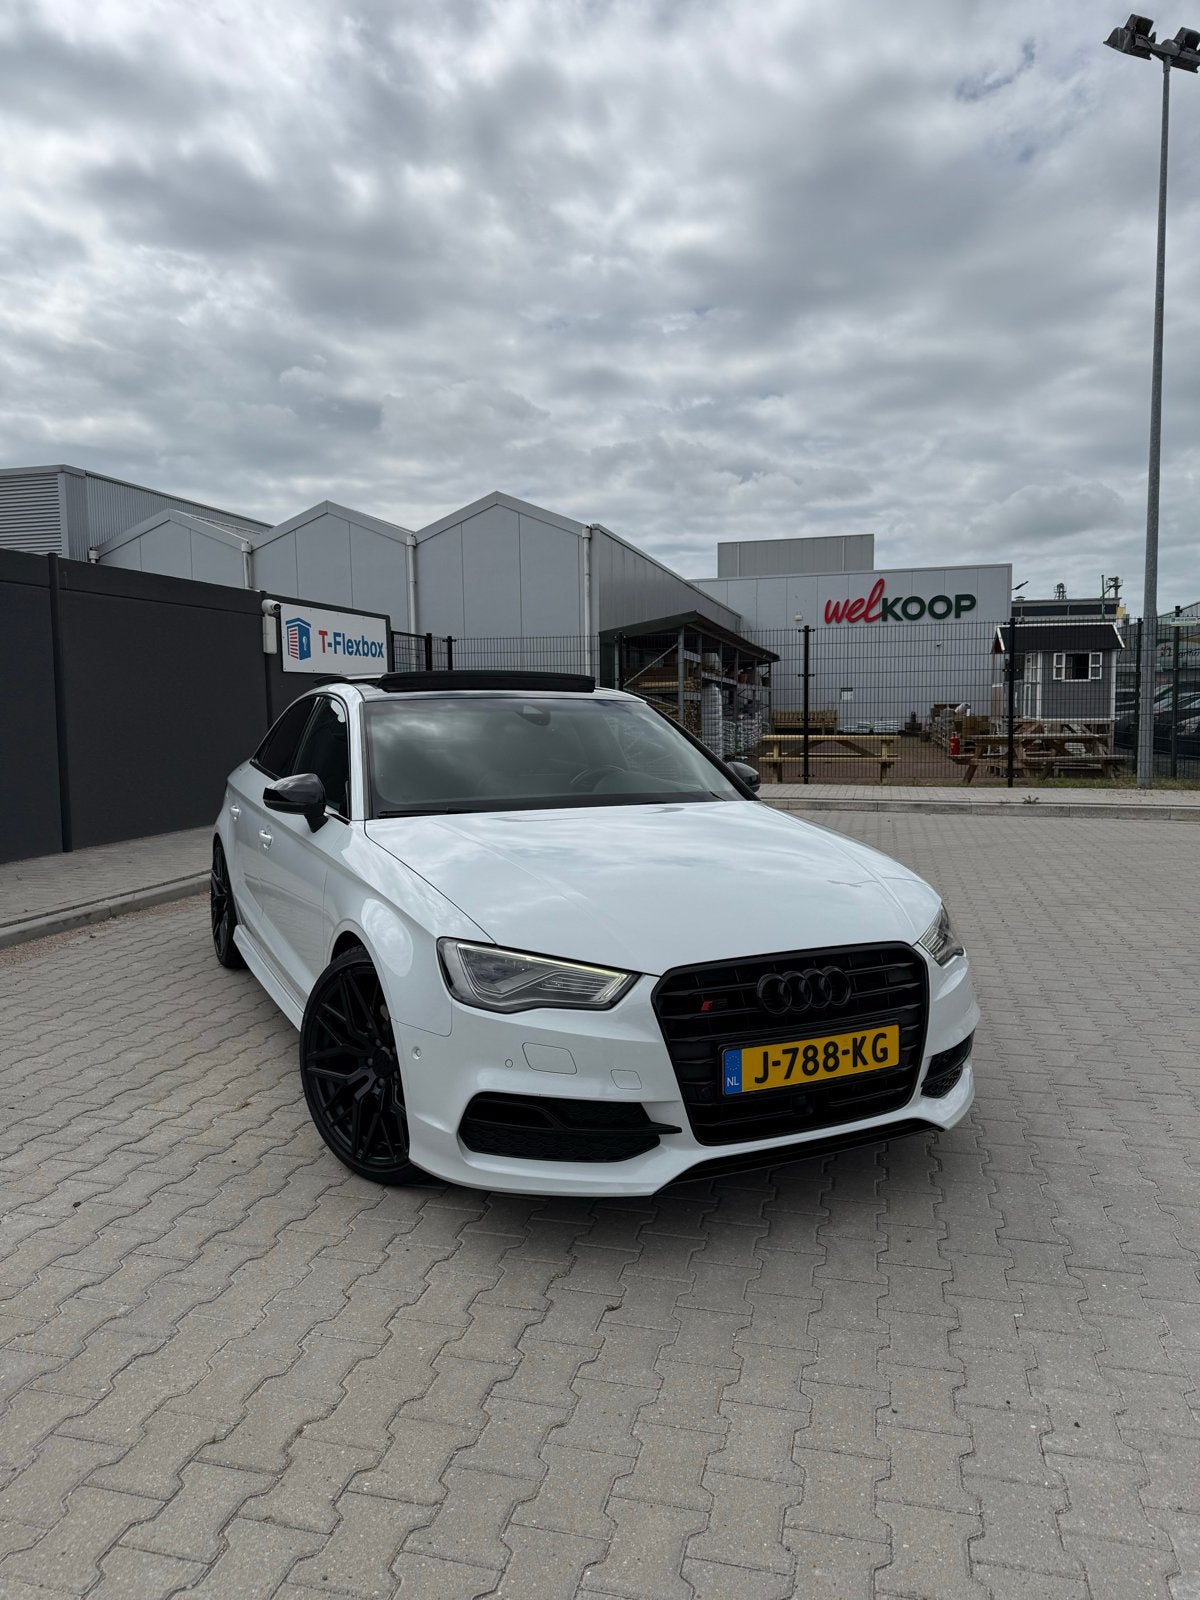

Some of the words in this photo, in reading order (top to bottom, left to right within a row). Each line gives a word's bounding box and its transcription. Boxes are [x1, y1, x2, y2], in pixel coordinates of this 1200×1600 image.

[318, 630, 385, 658] T-Flexbox
[754, 1032, 889, 1084] J-788-KG
[726, 1077, 740, 1087] NL
